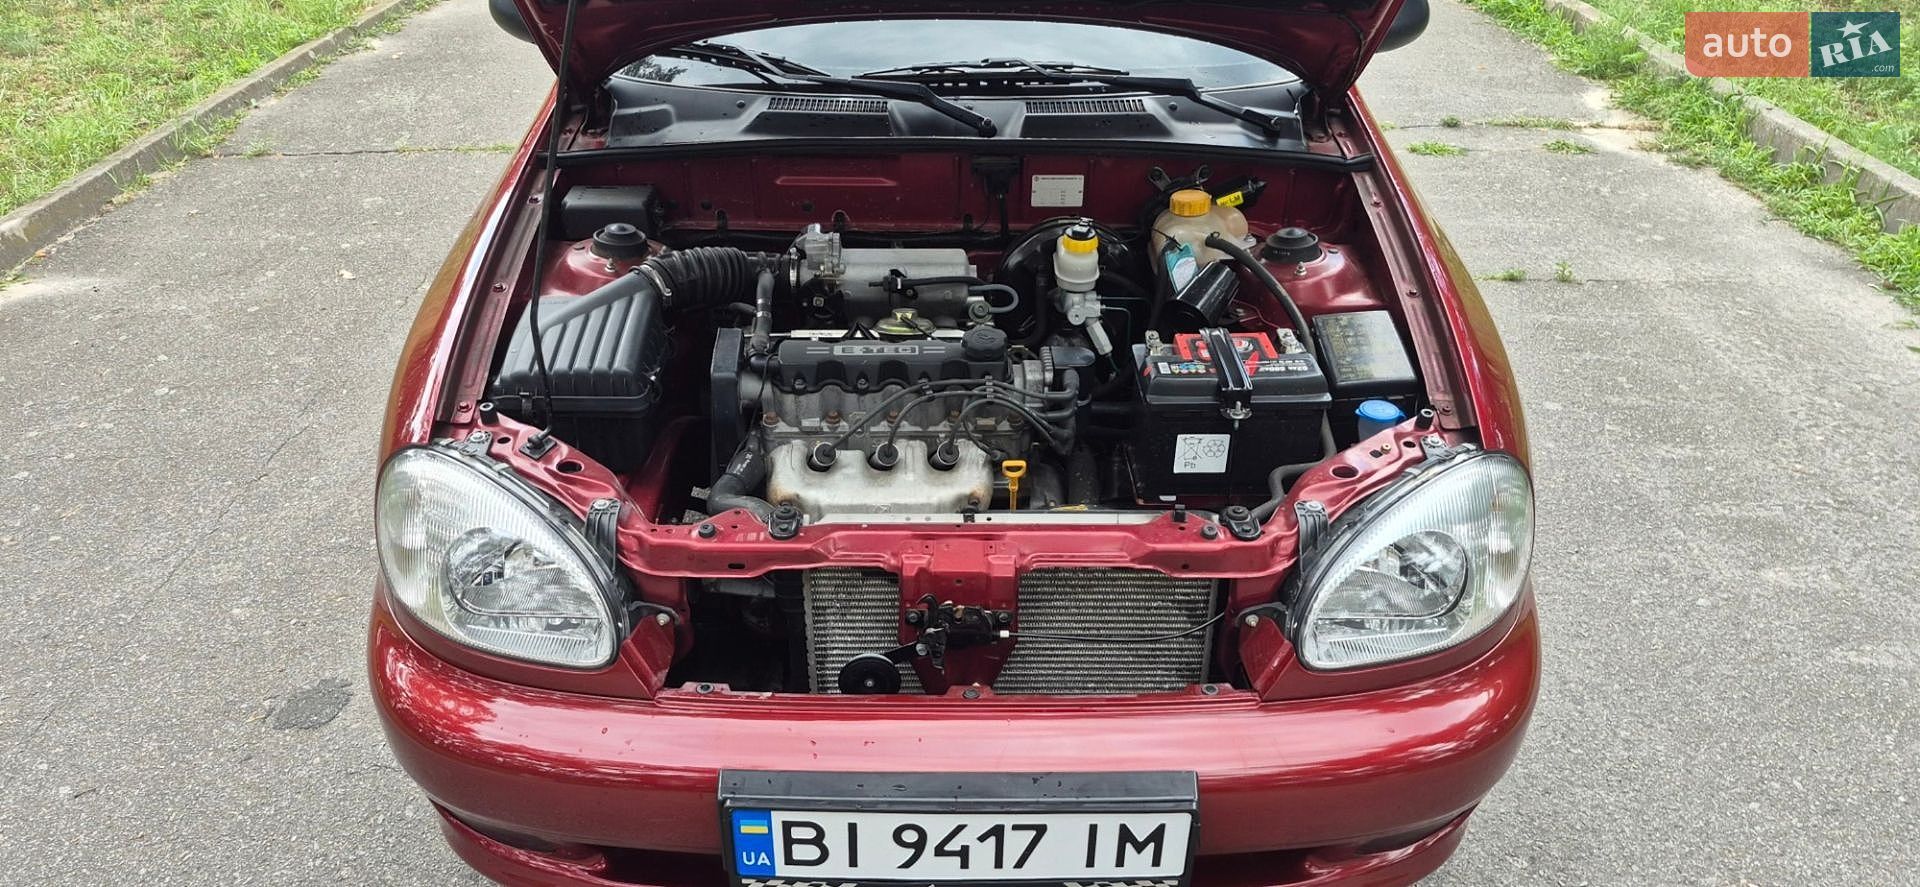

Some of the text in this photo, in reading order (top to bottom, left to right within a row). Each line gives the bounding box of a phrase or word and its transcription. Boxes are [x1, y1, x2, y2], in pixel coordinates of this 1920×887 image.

[742, 851, 772, 866] UA
[781, 820, 1166, 870] BI 9417 IM
